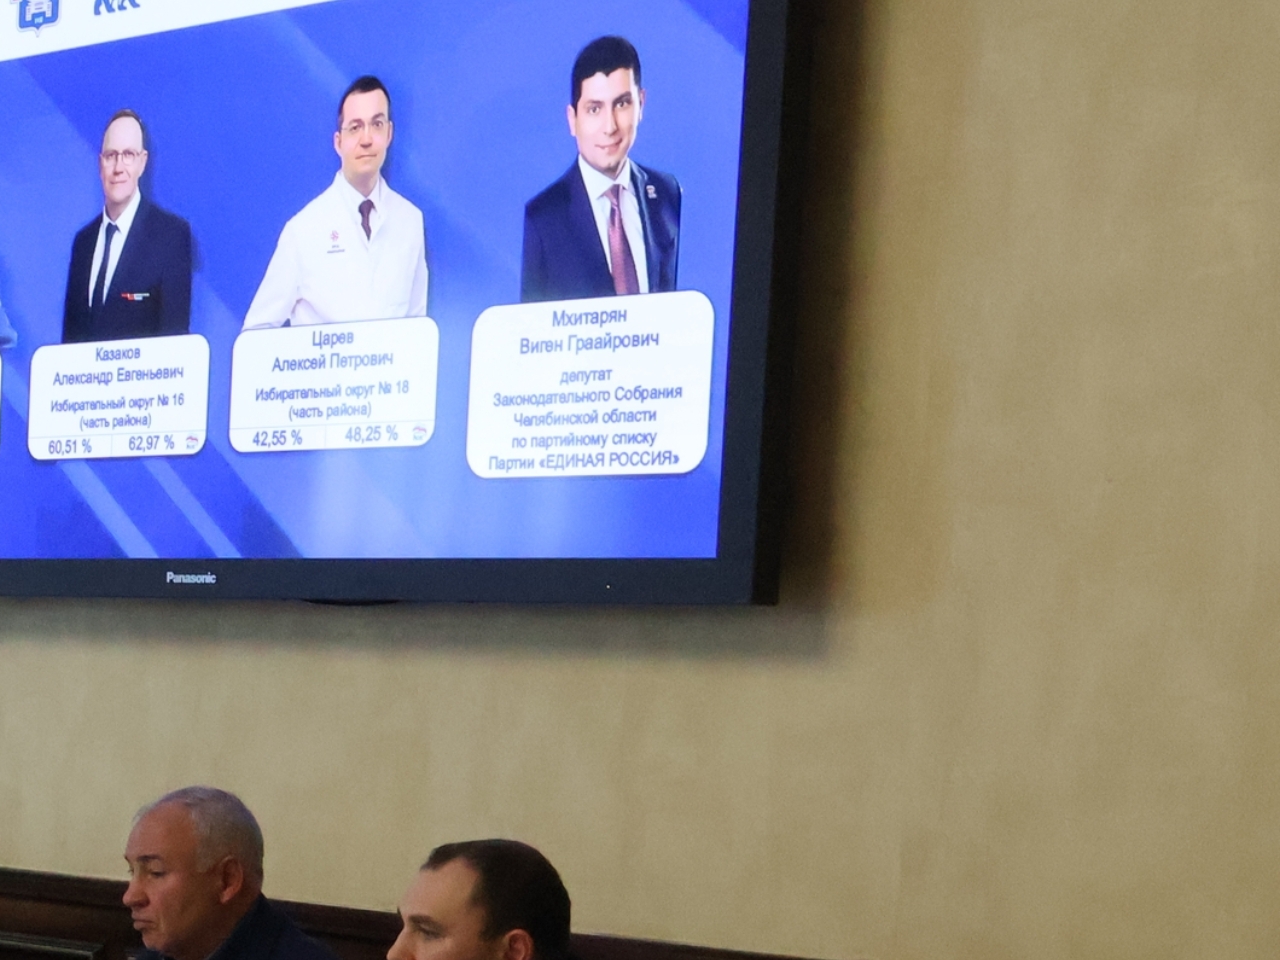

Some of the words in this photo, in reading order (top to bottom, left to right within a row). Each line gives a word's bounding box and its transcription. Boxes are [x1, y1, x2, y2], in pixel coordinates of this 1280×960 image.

[552, 309, 627, 328] Мхитарян
[312, 330, 354, 349] Царев
[520, 337, 563, 354] Виген
[567, 332, 659, 355] Граайрович
[96, 347, 140, 361] Казаков
[272, 355, 325, 372] Алексей
[330, 353, 393, 370] Петрович
[53, 372, 112, 386] Александр
[117, 367, 183, 382] Евгеньевич
[560, 368, 612, 386] депутат
[256, 384, 341, 403] Избирательный
[345, 384, 374, 399] округ
[378, 381, 391, 394] №
[396, 380, 409, 393] 18
[493, 391, 610, 408] Законодательного
[615, 384, 682, 403] Собрания
[51, 397, 125, 413] Избирательный
[129, 398, 154, 410] округ
[158, 394, 168, 407] №
[173, 393, 184, 406] 16
[289, 405, 323, 421] (часть
[326, 402, 371, 419] района)
[80, 416, 109, 431] (часть
[112, 413, 151, 429] района)
[514, 410, 598, 427] Челябинской
[602, 408, 656, 423] области
[129, 436, 159, 452] 62,97
[164, 435, 174, 450] %
[253, 430, 286, 448] 42,55
[291, 429, 302, 445] %
[345, 426, 381, 443] 48,25
[386, 425, 398, 441] %
[512, 435, 527, 448] по
[530, 432, 608, 450] партийному
[612, 430, 657, 446] списку
[49, 440, 77, 455] 60,51
[82, 439, 92, 453] %
[488, 456, 534, 473] Партии
[539, 453, 605, 471] «ЕДИНАЯ
[609, 450, 679, 466] РОССИЯ»
[166, 571, 216, 583] Panasonic
